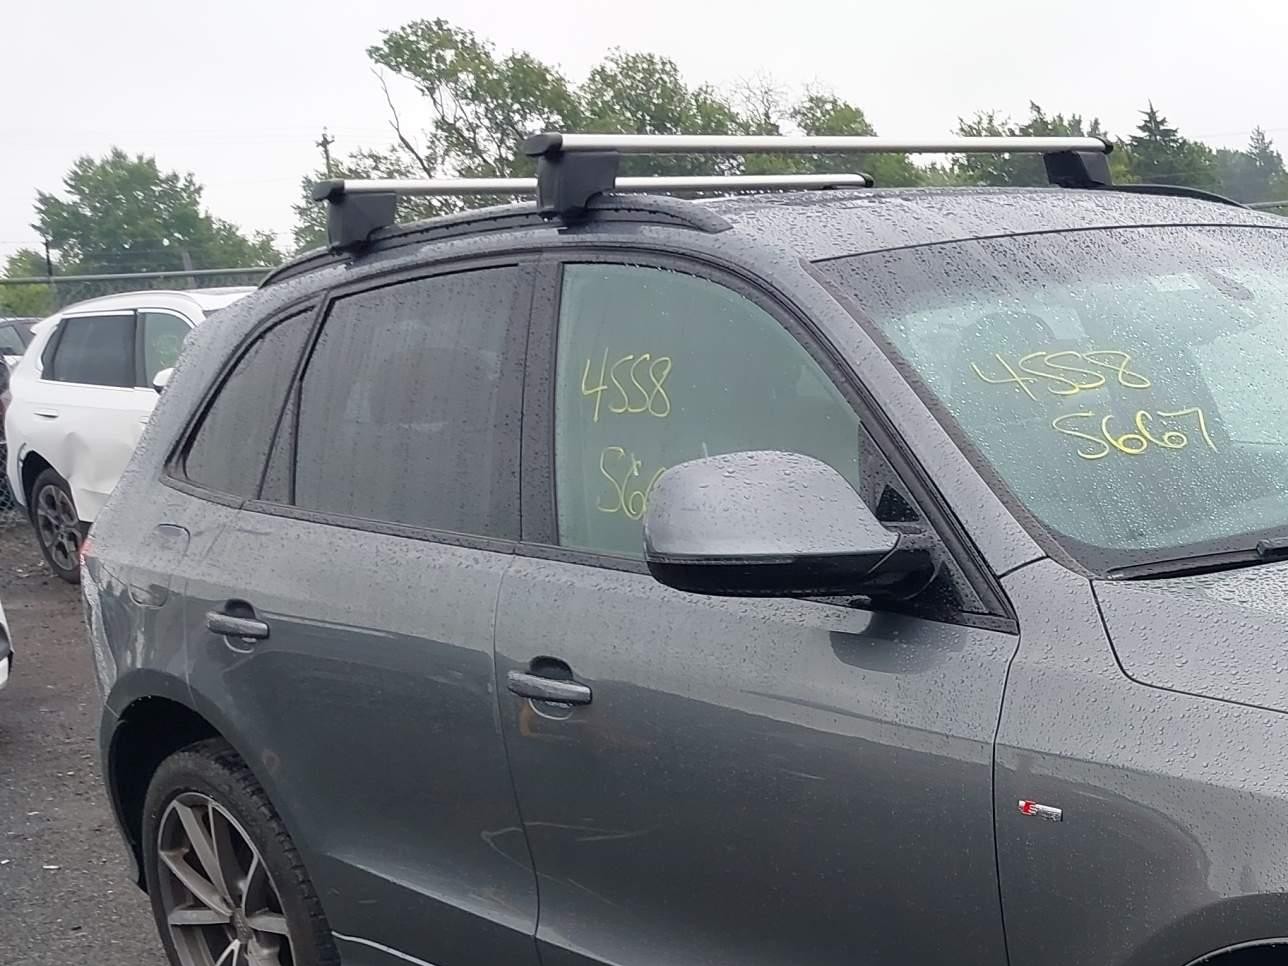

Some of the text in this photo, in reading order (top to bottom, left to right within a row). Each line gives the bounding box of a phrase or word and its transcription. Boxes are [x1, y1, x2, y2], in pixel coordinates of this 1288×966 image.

[581, 347, 672, 423] 4558
[970, 350, 1152, 401] 4558
[1052, 406, 1218, 459] 5667
